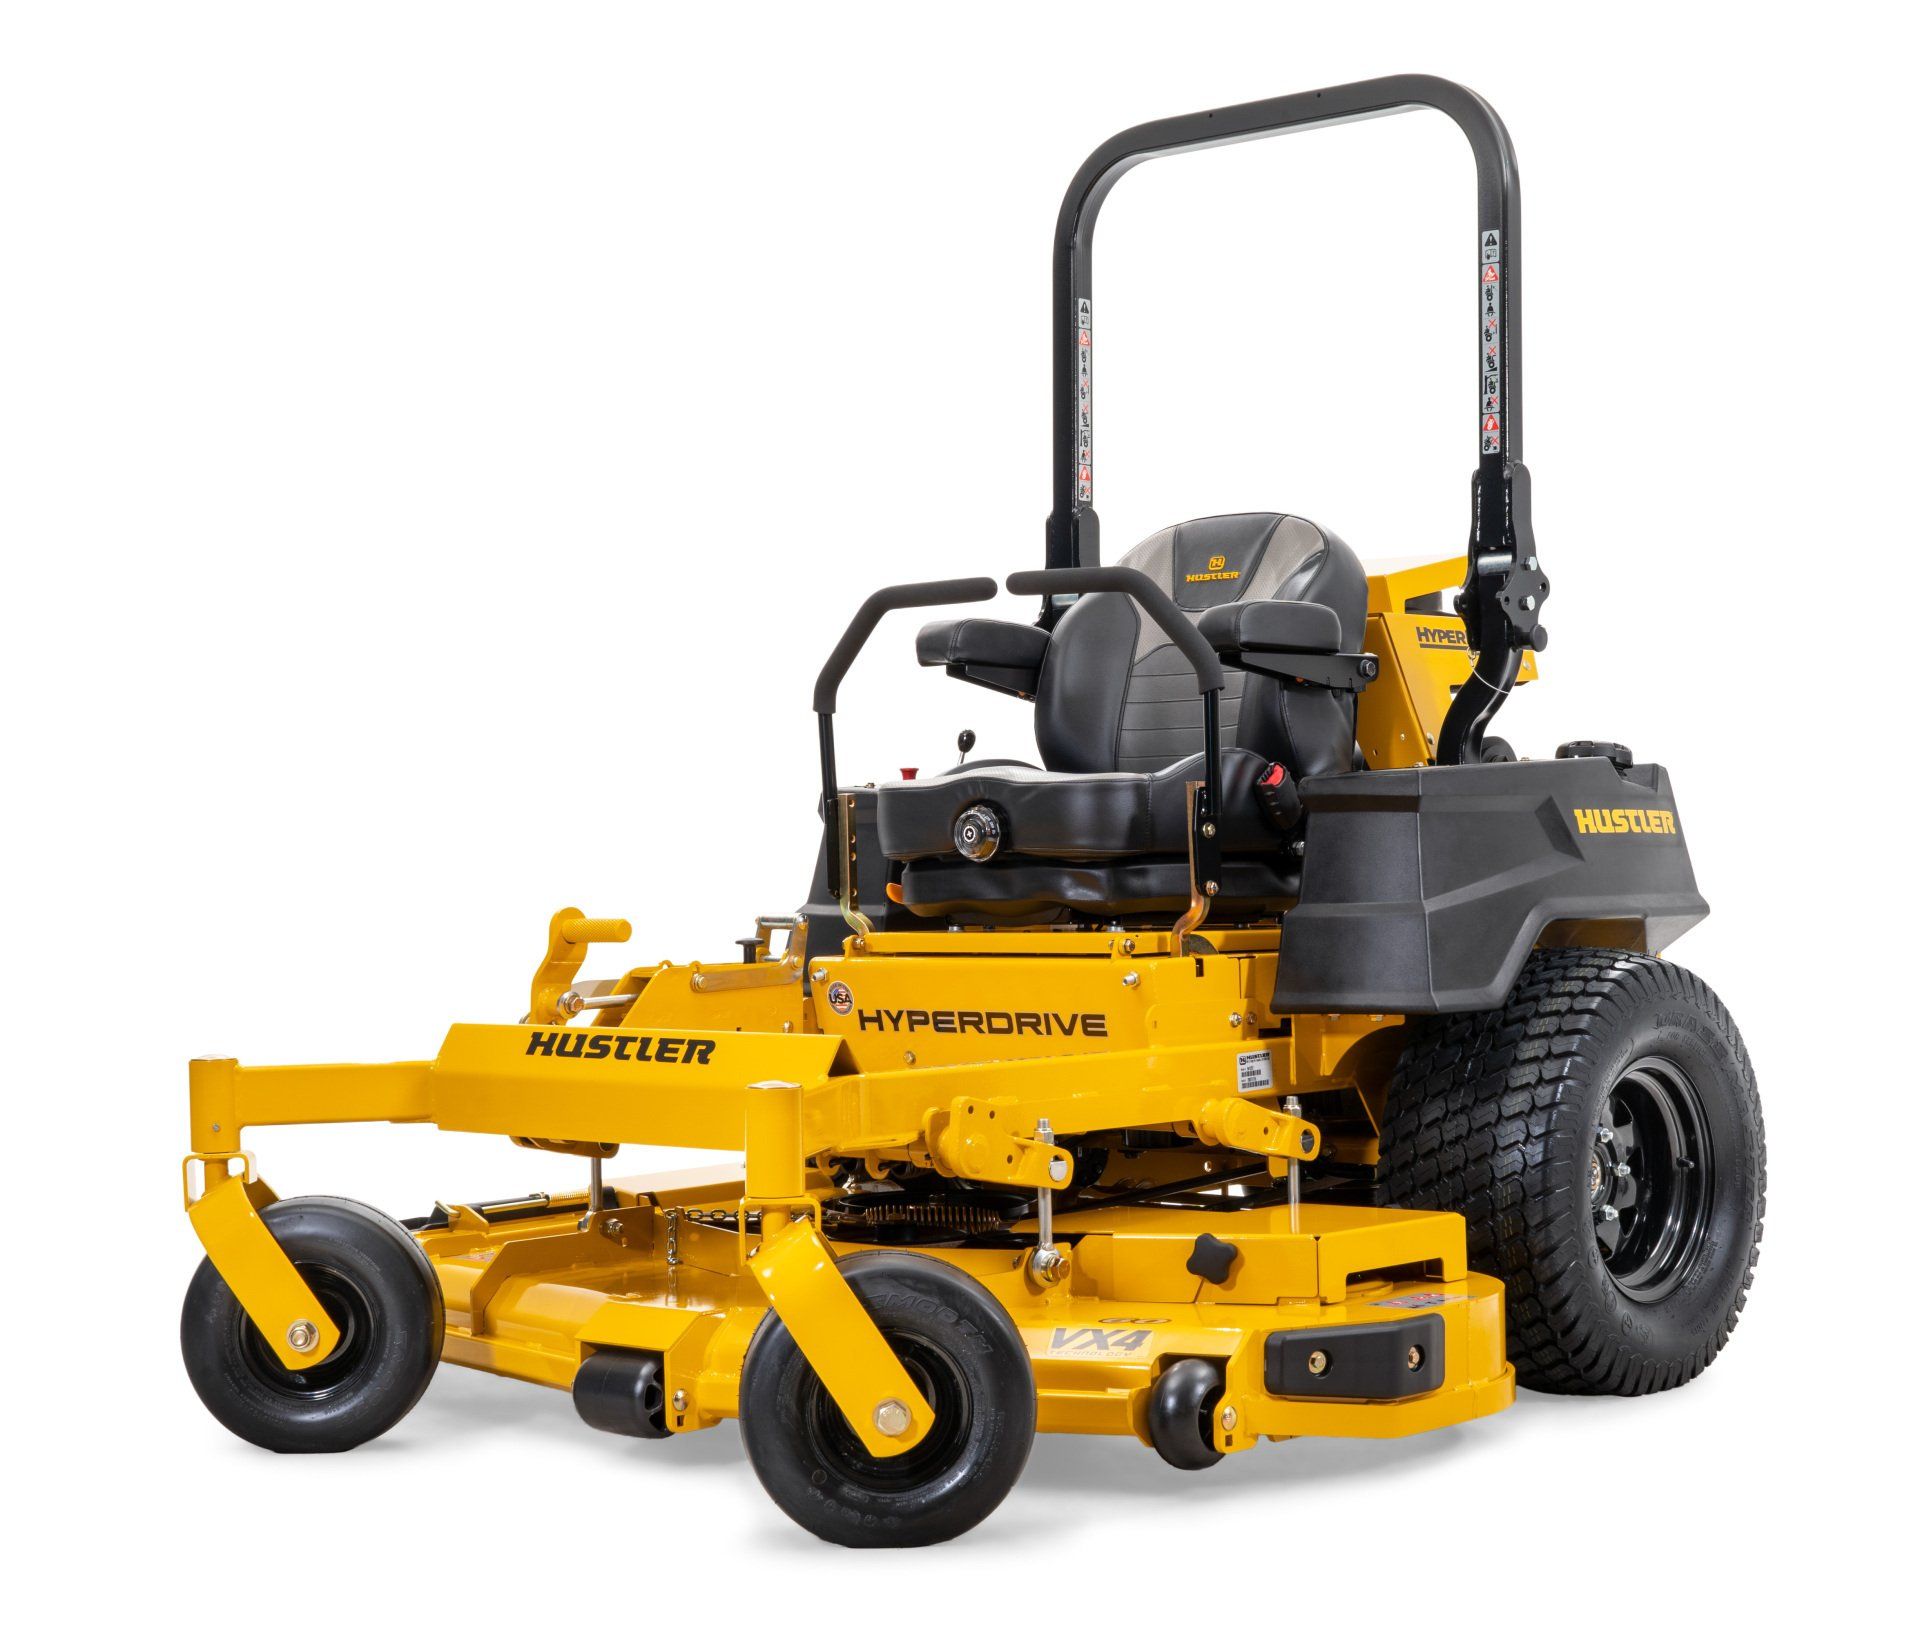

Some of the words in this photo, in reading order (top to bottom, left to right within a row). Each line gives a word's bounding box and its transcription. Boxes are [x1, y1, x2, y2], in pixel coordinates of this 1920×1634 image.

[1185, 571, 1240, 583] HUSTLER
[1415, 626, 1468, 645] HYPER
[1573, 809, 1677, 834] HUSTLER
[829, 993, 853, 1004] USA
[857, 1008, 1109, 1038] HYPERDRIVE
[525, 1031, 717, 1065] HUSTLER
[1050, 1327, 1153, 1352] VX4
